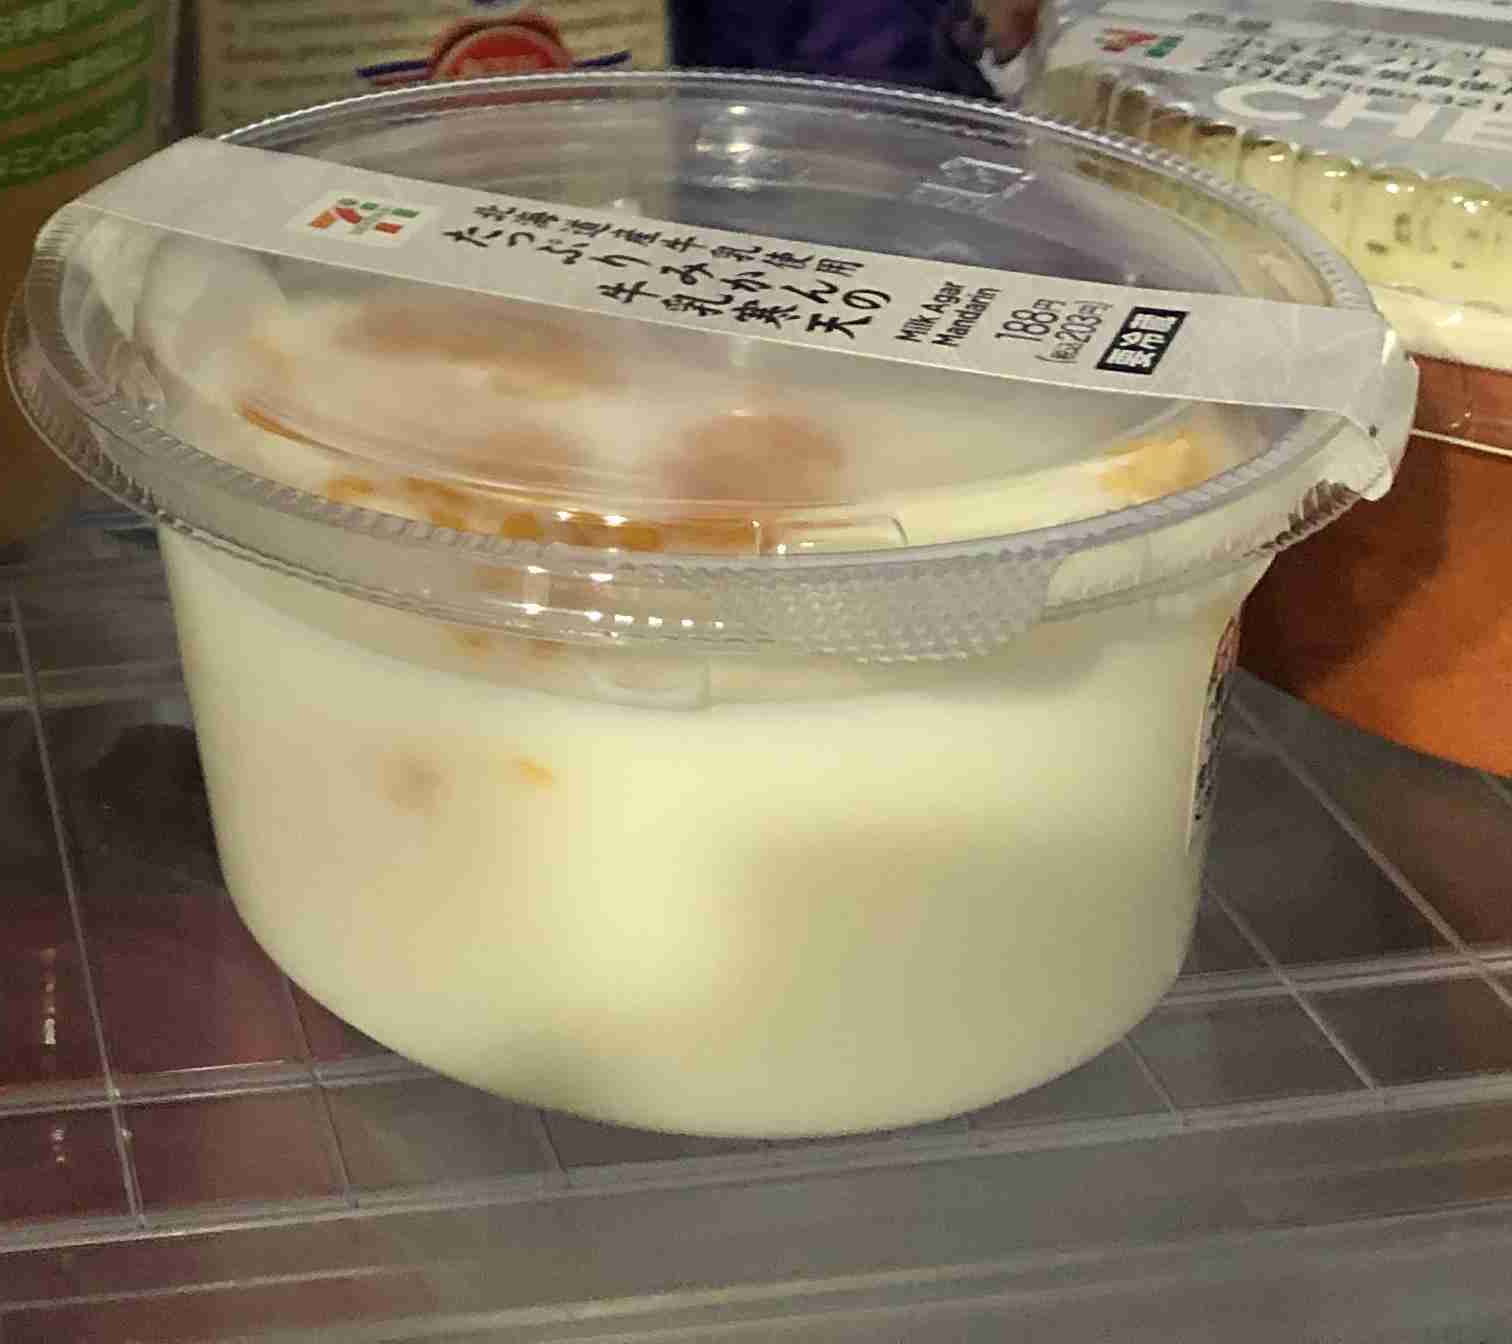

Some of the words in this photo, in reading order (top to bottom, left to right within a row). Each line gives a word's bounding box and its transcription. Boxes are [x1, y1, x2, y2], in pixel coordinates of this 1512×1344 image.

[442, 225, 892, 311] たっぷりみかんの
[597, 280, 873, 340] 牛乳寒天
[896, 313, 939, 343] Milk
[922, 280, 967, 315] Agar
[931, 287, 1003, 348] Mandarin
[1106, 312, 1180, 369] 要冷蔵
